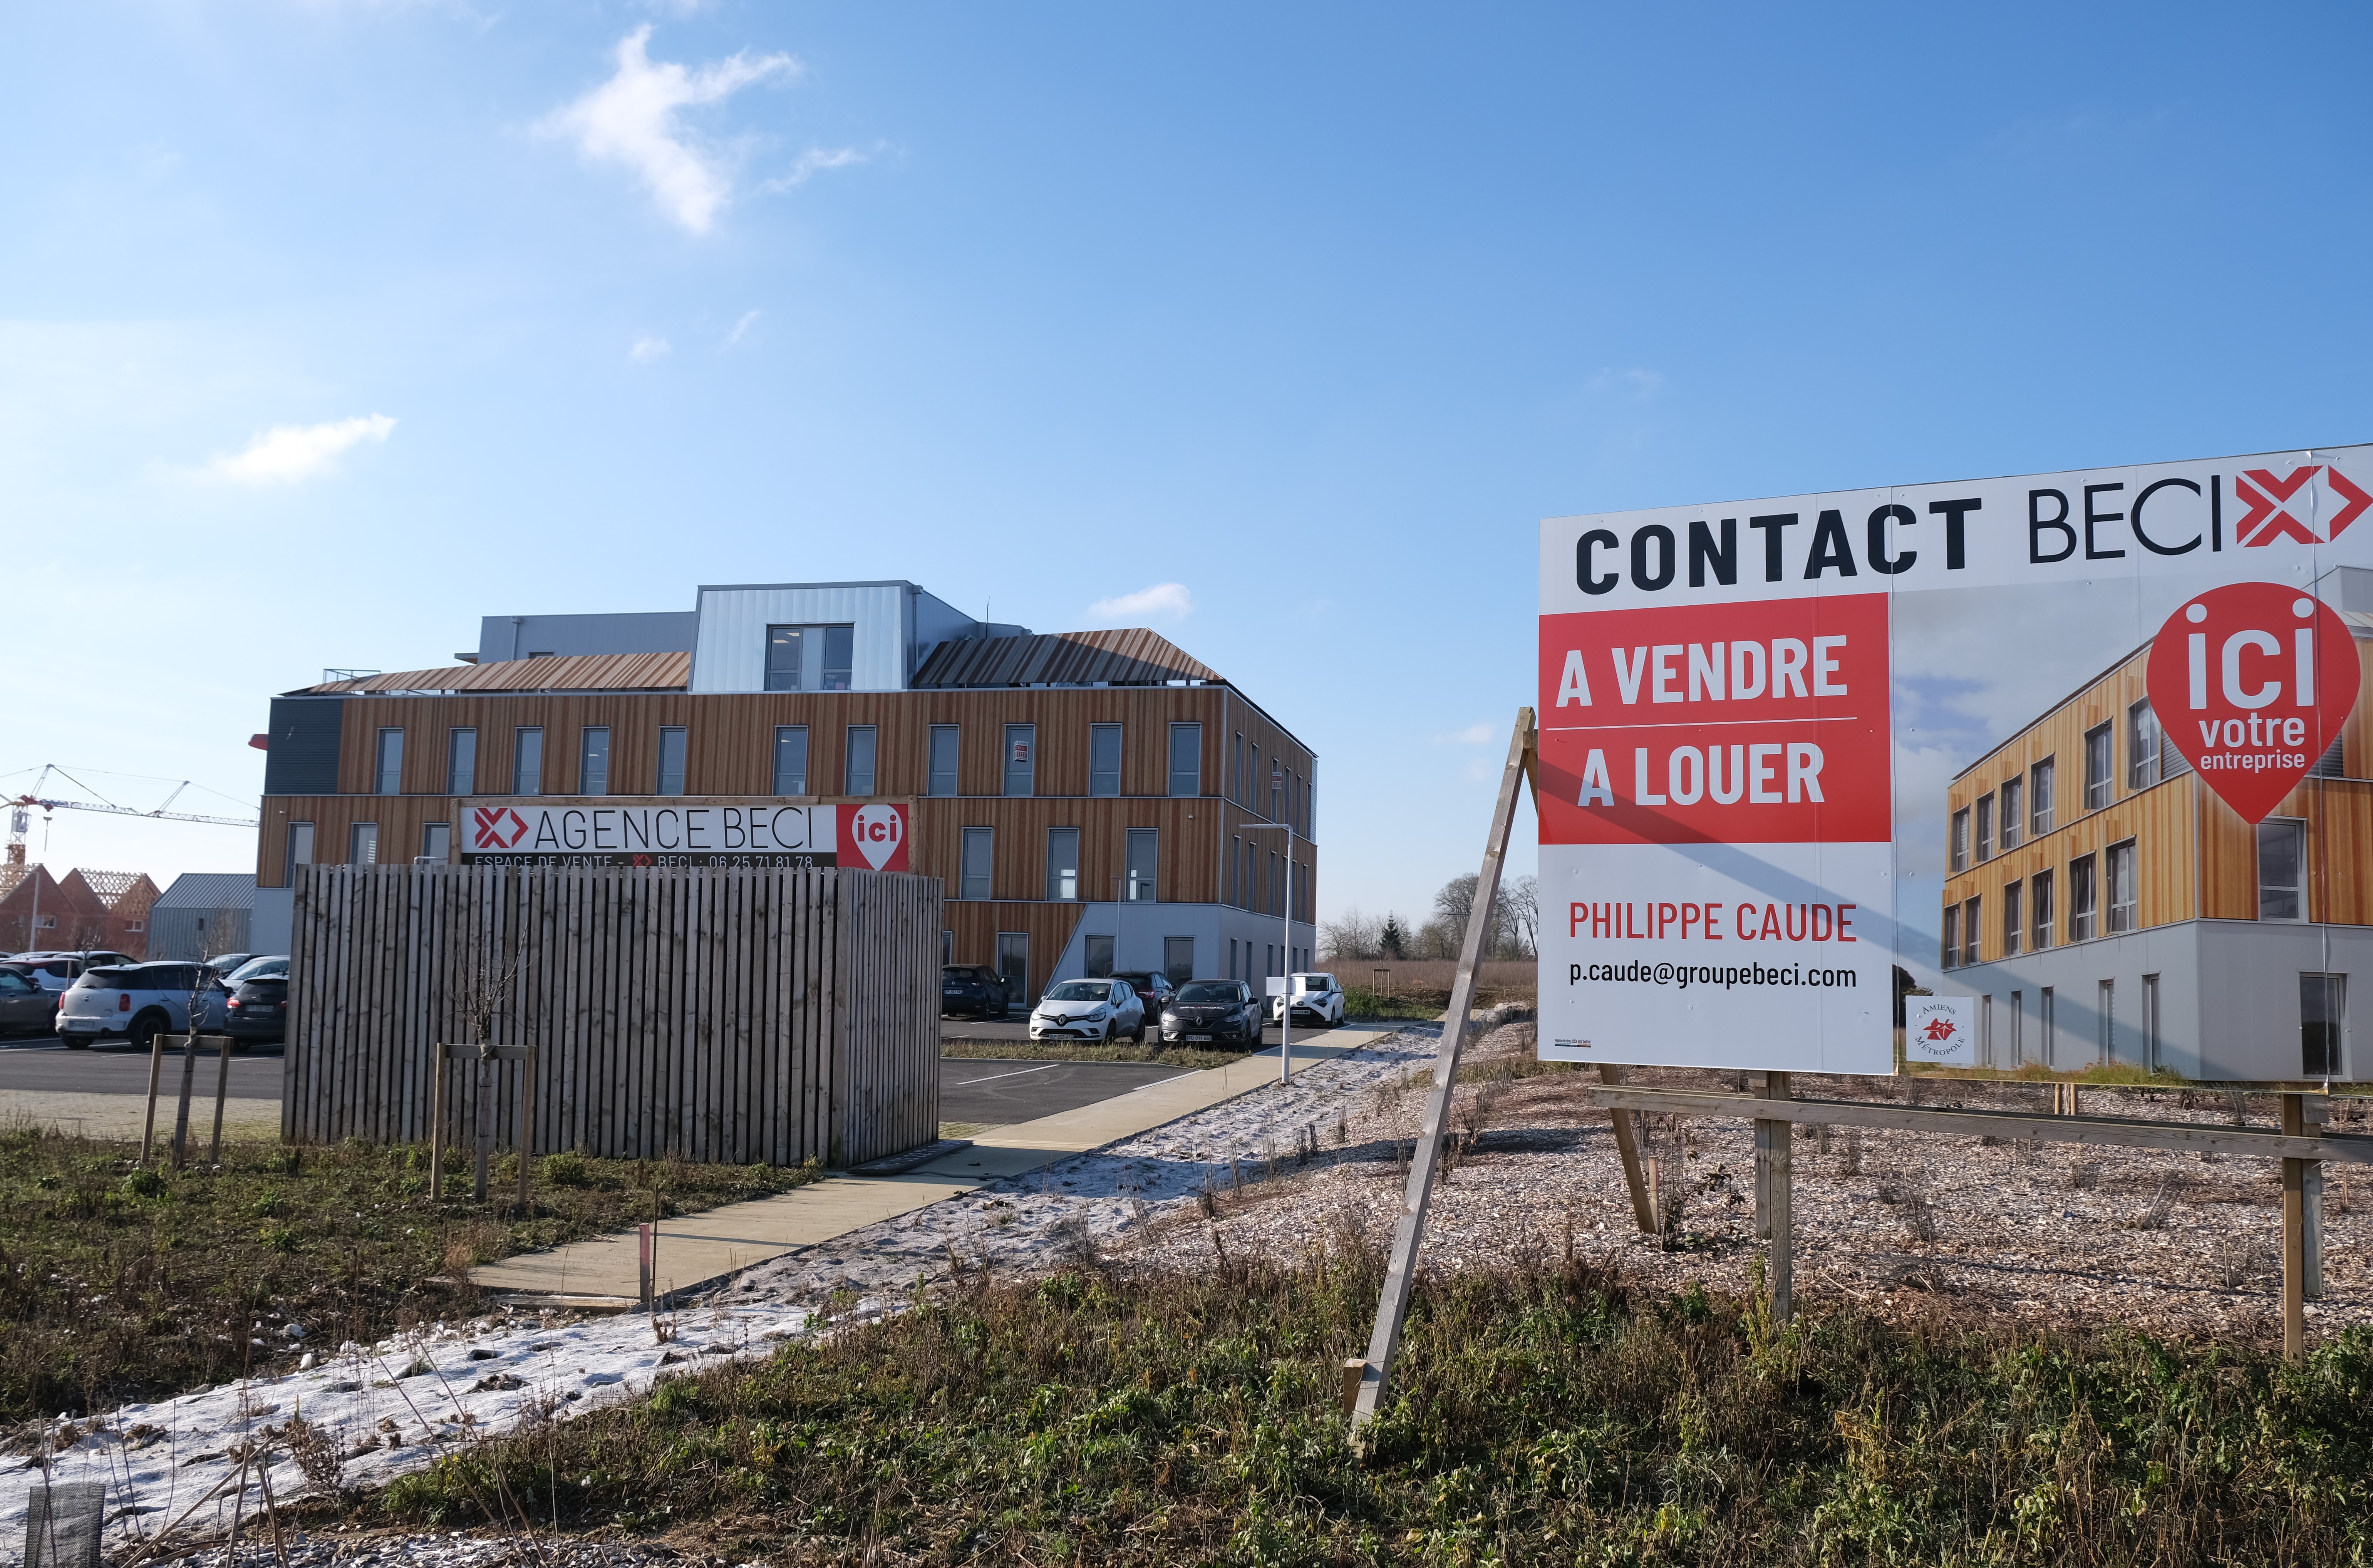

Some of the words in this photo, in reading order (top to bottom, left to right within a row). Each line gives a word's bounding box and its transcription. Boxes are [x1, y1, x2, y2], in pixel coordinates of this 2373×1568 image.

[1576, 498, 1981, 595] CONTACT
[2029, 475, 2222, 564] BECI
[1555, 650, 1593, 707] A
[1611, 635, 1847, 705] VENDRE
[2186, 598, 2314, 710] ici
[2199, 712, 2305, 747] votre
[1577, 748, 1615, 807] A
[1635, 742, 1825, 806] LOUER
[2200, 749, 2305, 774] entreprise
[535, 809, 711, 849] AGENCE
[724, 807, 812, 849] BECI
[858, 814, 897, 842] ici
[562, 856, 612, 868] VENTE
[709, 856, 727, 869] 06
[733, 856, 750, 868] 25
[756, 856, 769, 869] 71
[776, 856, 789, 869] 81
[796, 856, 813, 869] 78
[1570, 902, 1723, 940] PHILIPPE
[1736, 903, 1857, 942] CAUDE
[1570, 960, 1857, 989] p.caude@groupebeci.com
[1922, 1004, 1956, 1015] AMIENS
[1914, 1035, 1965, 1056] MÉTROPOLE
